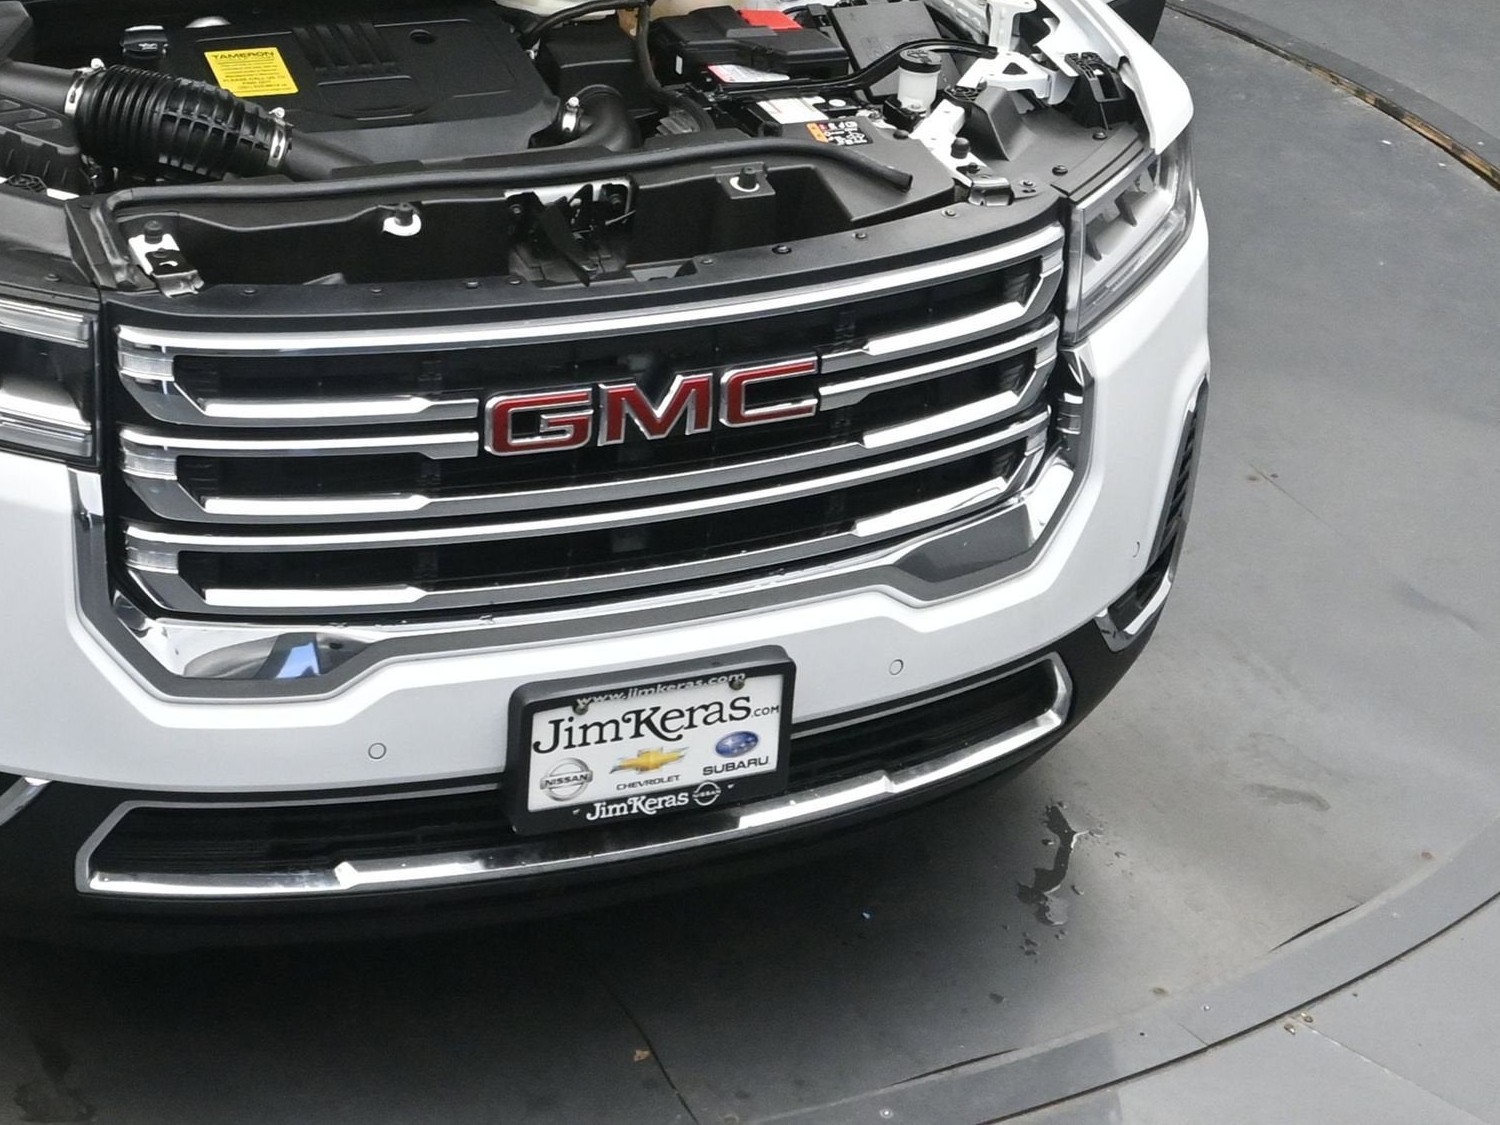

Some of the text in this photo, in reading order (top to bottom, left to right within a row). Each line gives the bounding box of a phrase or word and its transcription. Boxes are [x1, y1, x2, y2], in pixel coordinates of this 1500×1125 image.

[484, 356, 818, 457] GMC
[702, 756, 769, 776] SUBARU
[544, 773, 589, 786] NISSAN
[616, 775, 680, 791] CHEVROLET
[586, 792, 689, 821] JimKeras
